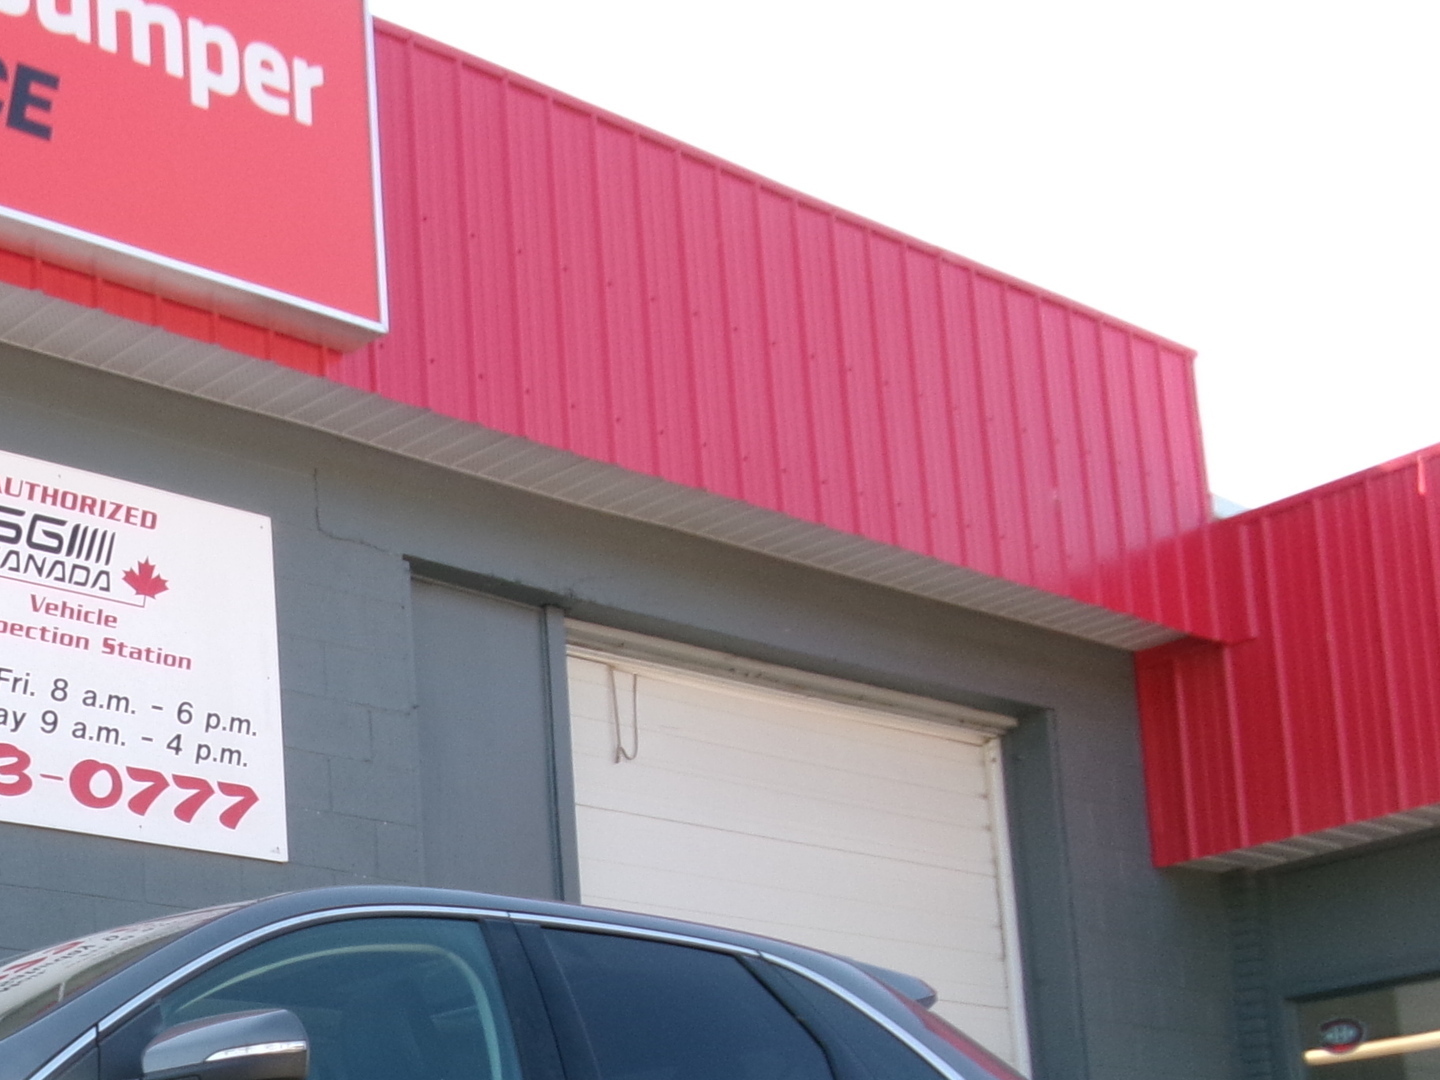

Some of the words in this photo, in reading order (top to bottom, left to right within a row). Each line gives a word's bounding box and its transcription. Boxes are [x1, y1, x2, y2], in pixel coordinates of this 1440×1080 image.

[31, 594, 117, 628] Vehicle
[102, 637, 191, 670] Station
[51, 678, 68, 702] 8
[82, 690, 135, 714] a.m.
[177, 702, 193, 724] 6
[205, 713, 256, 736] p.m.
[41, 710, 58, 733] 9
[72, 722, 125, 746] a.m.
[167, 734, 182, 755] 4
[196, 744, 247, 767] p.m.
